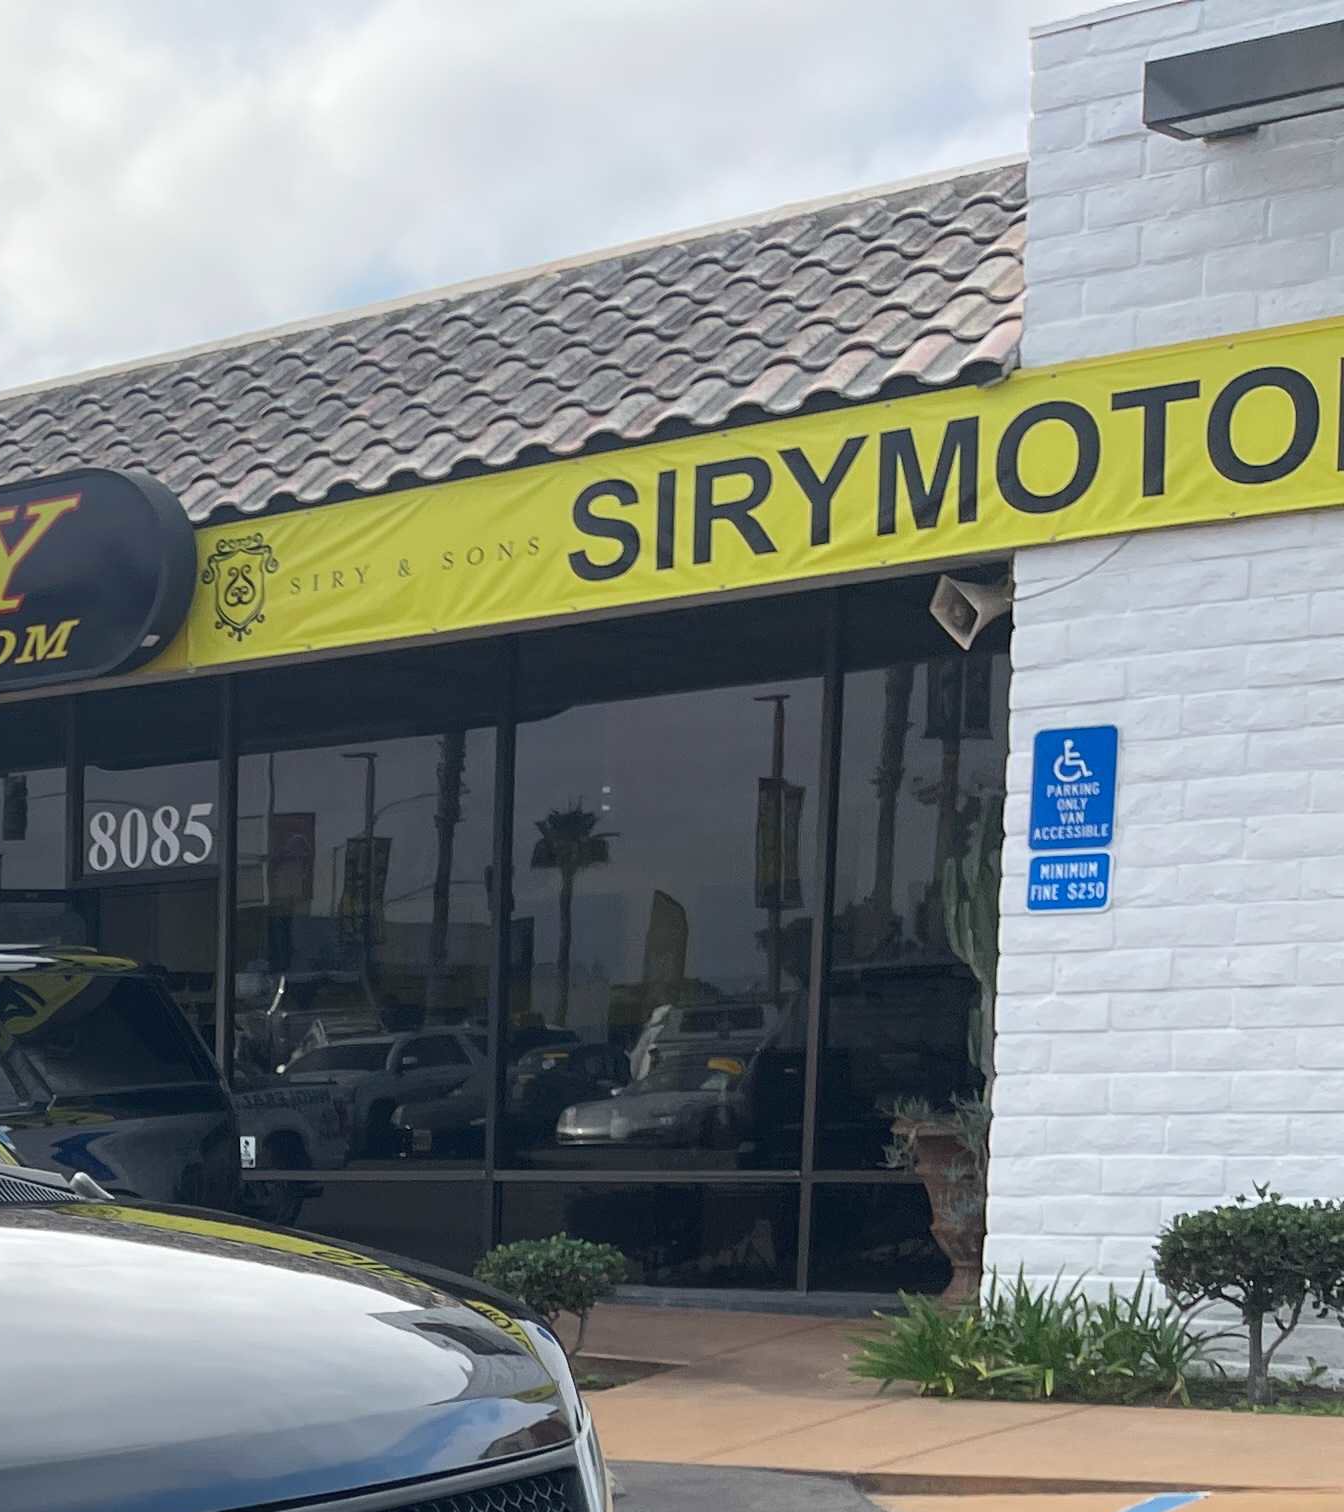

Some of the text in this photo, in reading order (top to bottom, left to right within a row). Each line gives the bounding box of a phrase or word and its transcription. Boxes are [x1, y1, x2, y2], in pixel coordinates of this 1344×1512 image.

[568, 358, 1344, 583] SIRYMOTO
[290, 536, 541, 595] SIRY & SONS
[1046, 782, 1100, 798] PARKING
[1056, 798, 1088, 811] ONLY
[1060, 812, 1084, 825] VAN
[88, 803, 214, 871] 8085
[1033, 823, 1109, 841] ACCESSIBLE
[1039, 861, 1099, 880] MINIMUM
[1030, 881, 1105, 902] FINE $250
